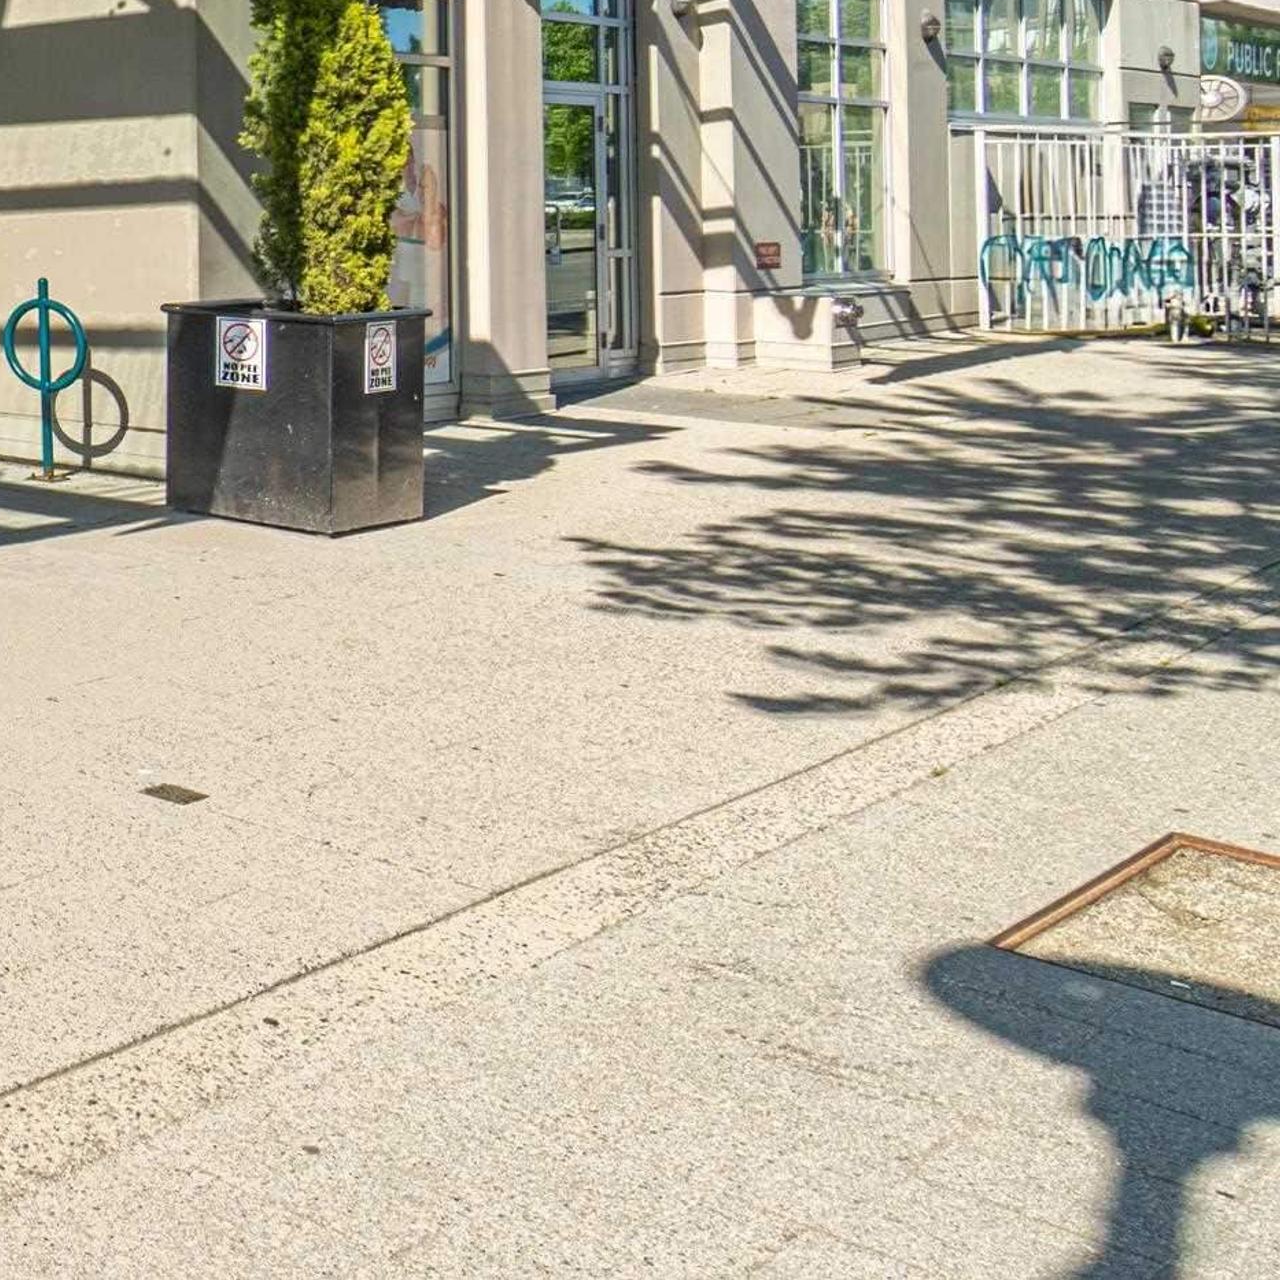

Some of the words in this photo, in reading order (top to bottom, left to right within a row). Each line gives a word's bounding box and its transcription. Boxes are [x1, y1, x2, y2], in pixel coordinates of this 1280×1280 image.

[1227, 41, 1272, 77] PUBLIC
[223, 362, 239, 371] NO
[371, 368, 379, 377] NO
[221, 371, 260, 384] ZONE
[370, 376, 393, 388] ZONE
